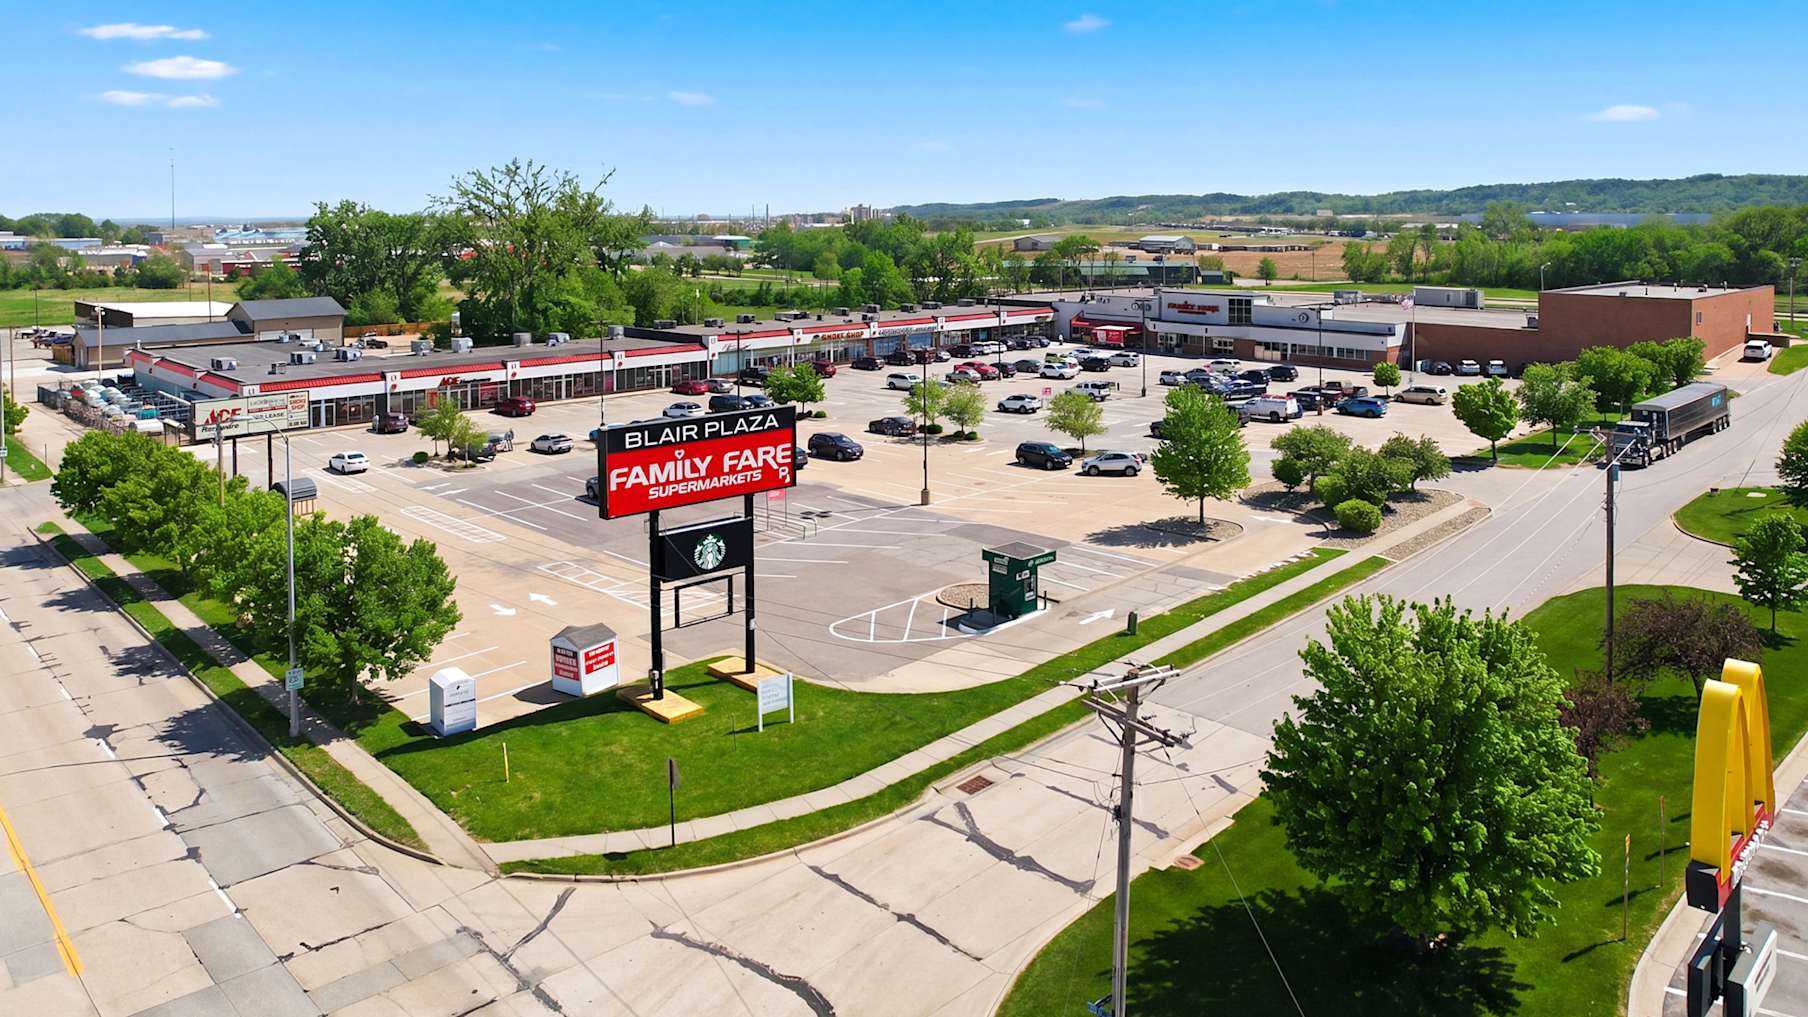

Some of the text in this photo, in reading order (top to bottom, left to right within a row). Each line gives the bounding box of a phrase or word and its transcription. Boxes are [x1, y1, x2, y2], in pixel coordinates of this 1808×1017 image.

[846, 331, 864, 339] SHOP
[204, 408, 241, 426] ACE
[625, 414, 779, 449] BLAIR PLAZA
[610, 443, 792, 492] FAMILY FARE
[648, 469, 762, 500] SUPERMARKETS
